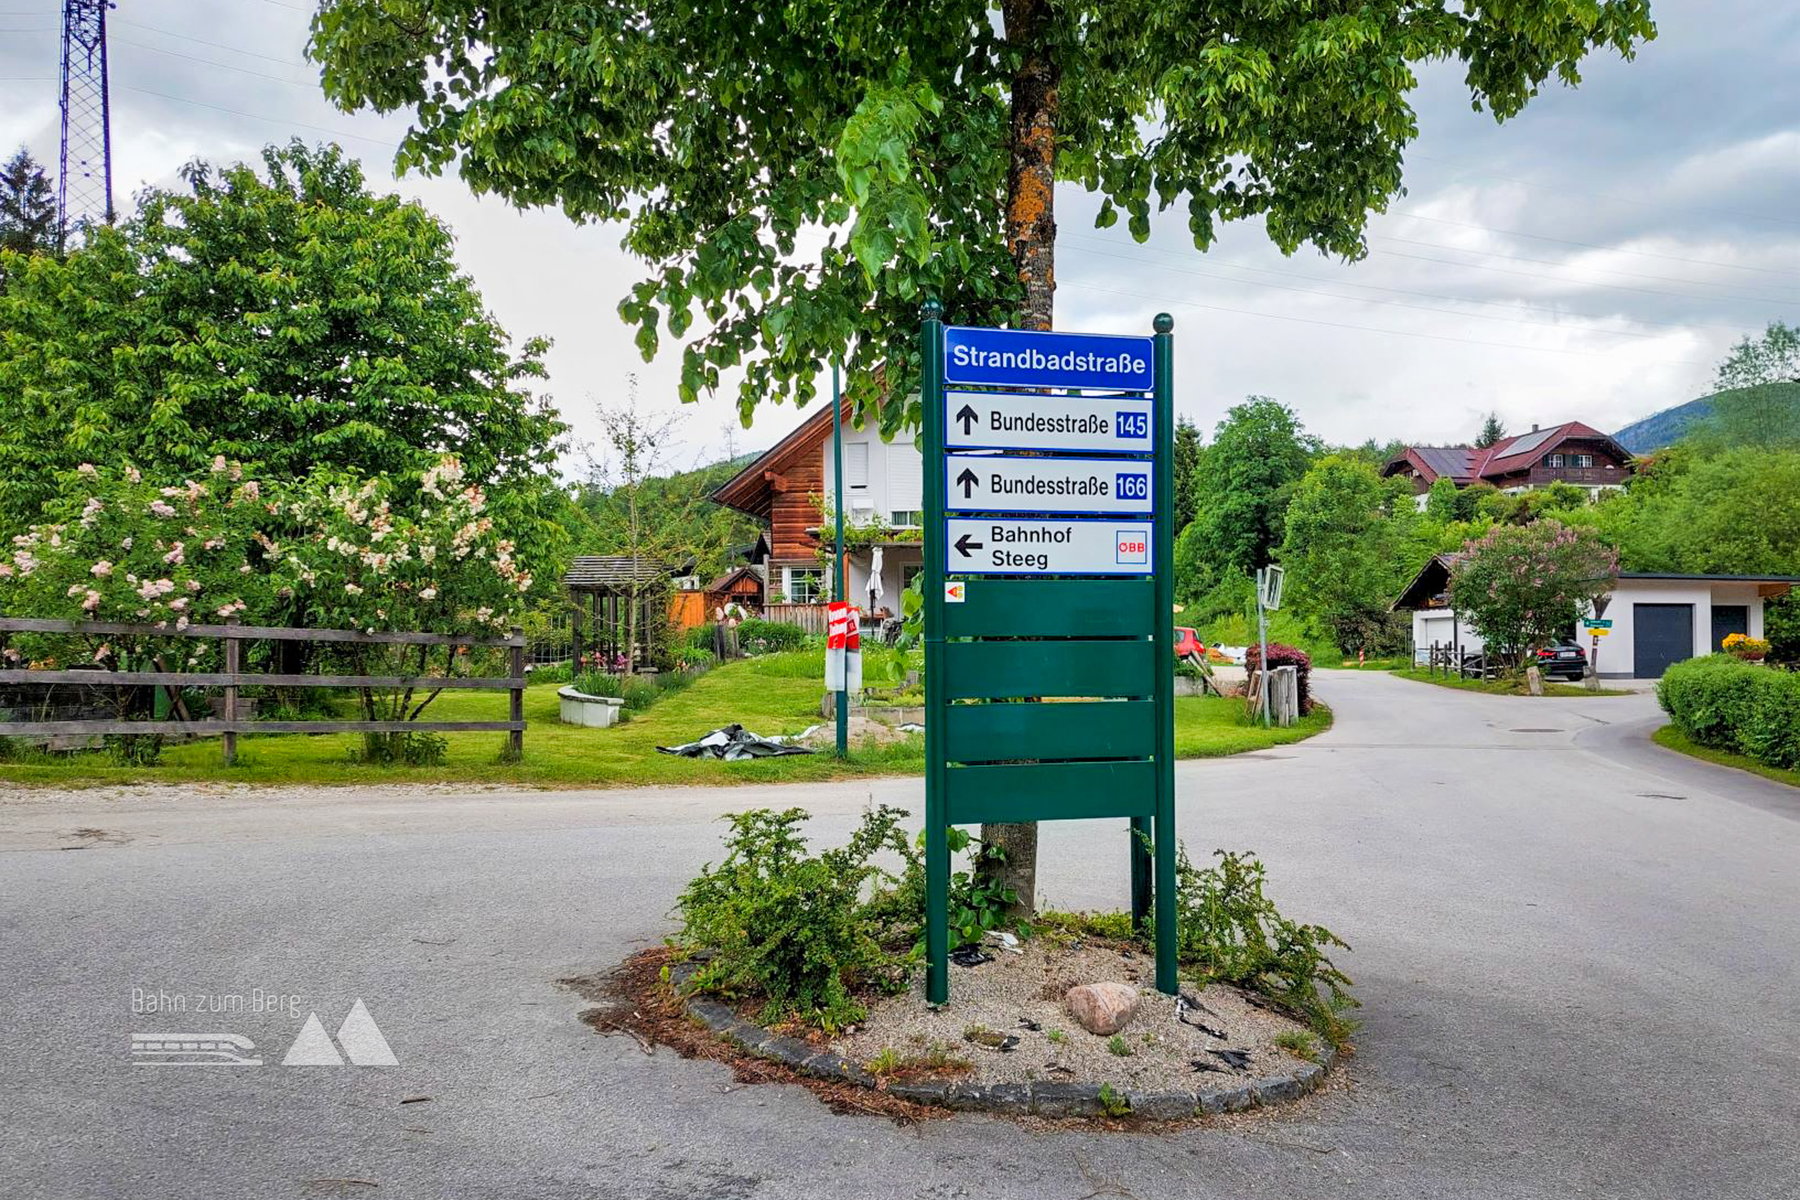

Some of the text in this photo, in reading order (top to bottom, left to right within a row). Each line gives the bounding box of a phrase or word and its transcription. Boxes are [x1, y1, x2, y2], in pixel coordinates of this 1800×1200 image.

[953, 345, 1146, 374] Strandbadstraße
[990, 411, 1146, 435] Bundesstraße 145
[990, 474, 1146, 496] Bundesstraße 166
[991, 526, 1072, 543] Bahnhof
[992, 550, 1048, 569] Steeg
